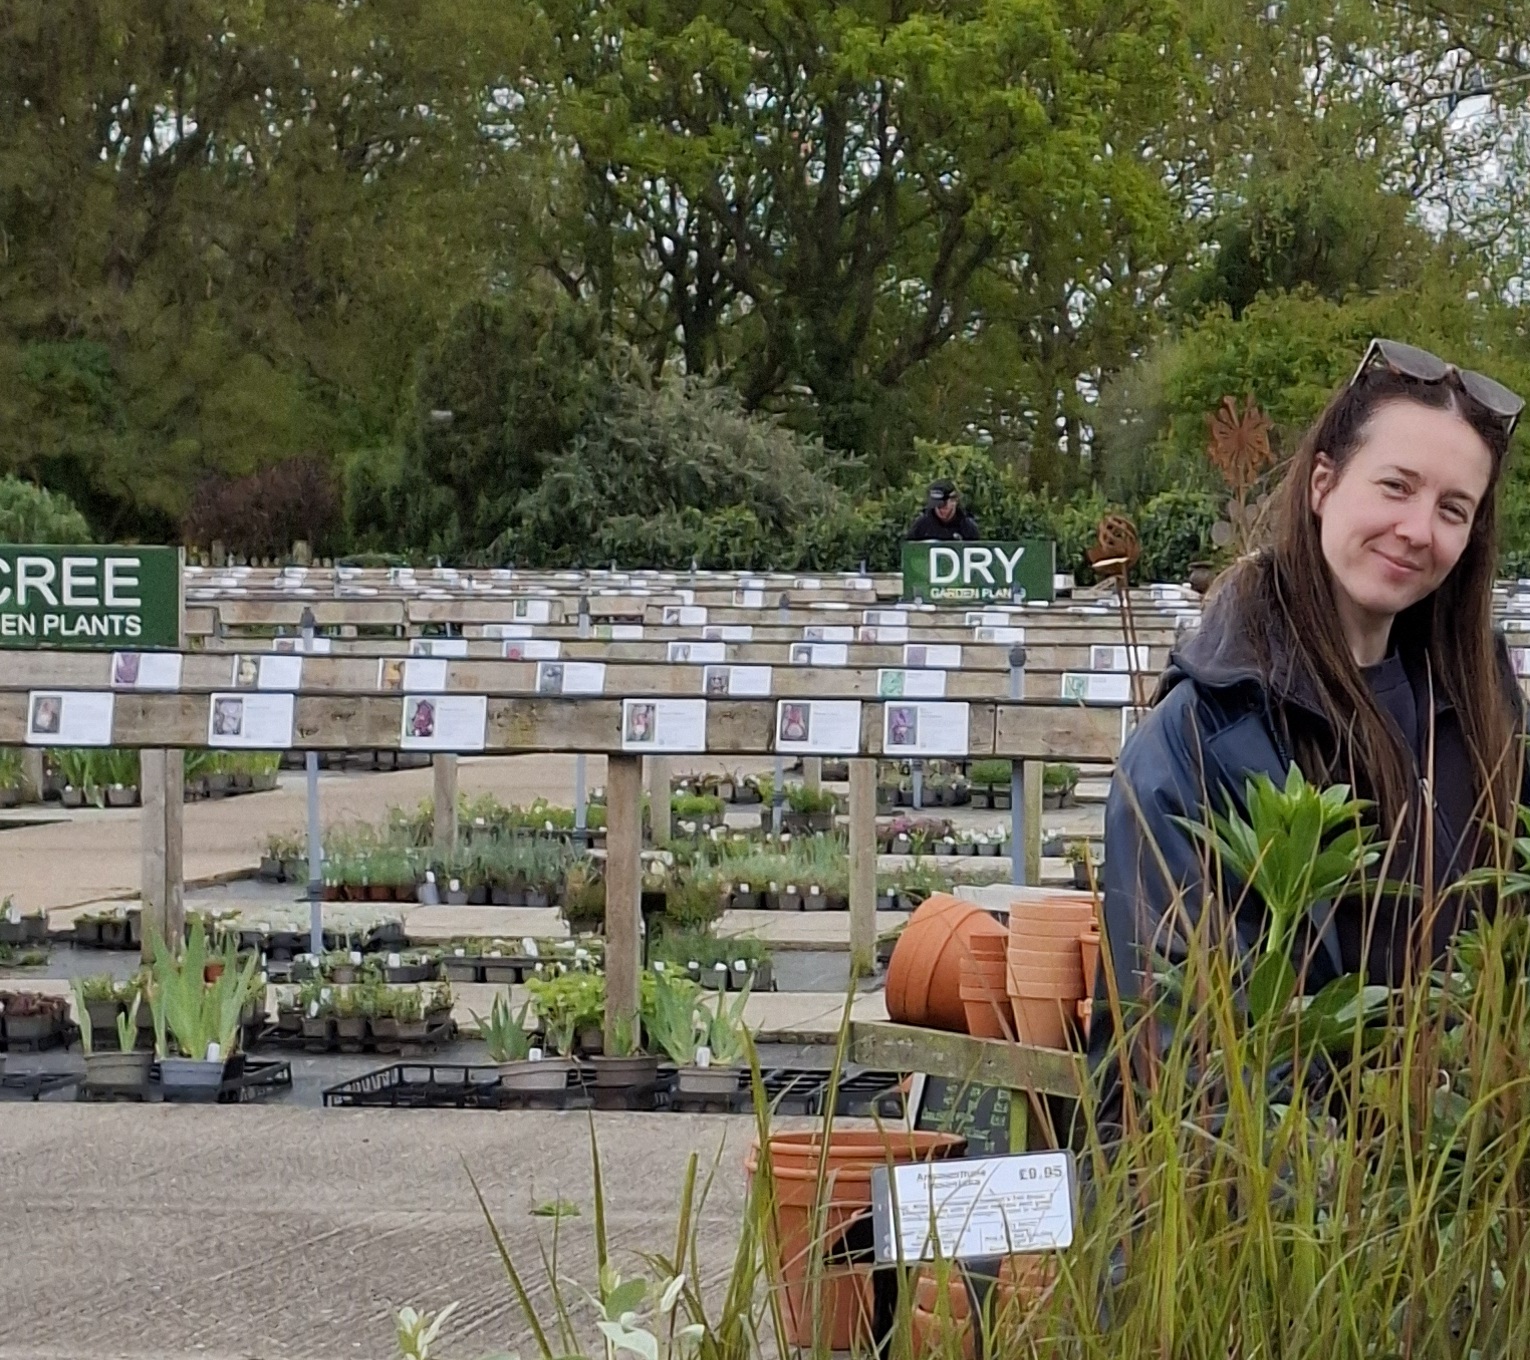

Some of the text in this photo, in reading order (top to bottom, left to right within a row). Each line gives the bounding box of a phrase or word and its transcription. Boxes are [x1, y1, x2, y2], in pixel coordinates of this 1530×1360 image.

[929, 547, 1025, 584] DRY
[0, 556, 142, 606] REE
[930, 587, 1027, 600] GARDEN PLANS
[1, 613, 142, 637] EN PLANTS
